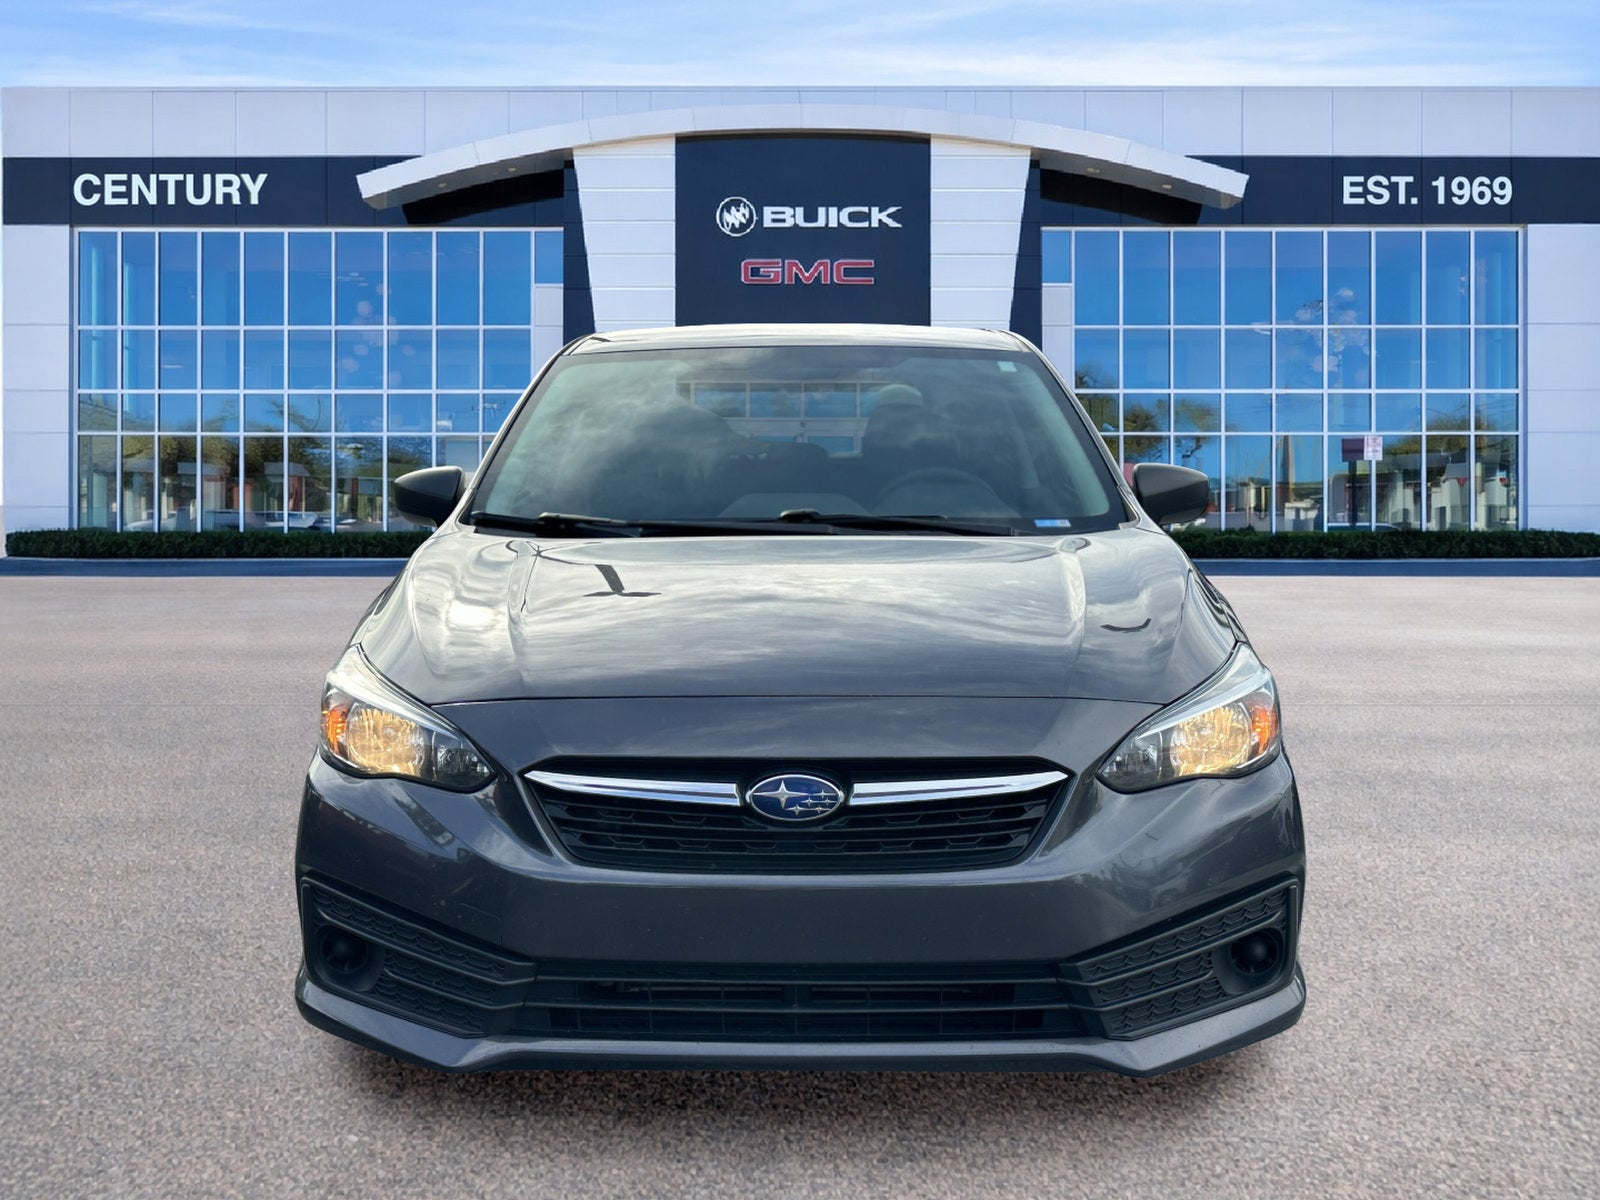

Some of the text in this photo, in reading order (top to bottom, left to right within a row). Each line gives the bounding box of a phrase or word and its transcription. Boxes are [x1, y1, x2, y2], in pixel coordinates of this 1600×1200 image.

[73, 173, 268, 206] CENTURY
[1342, 175, 1513, 206] EST. 1969
[762, 206, 903, 228] BUICK
[740, 258, 875, 285] GMC
